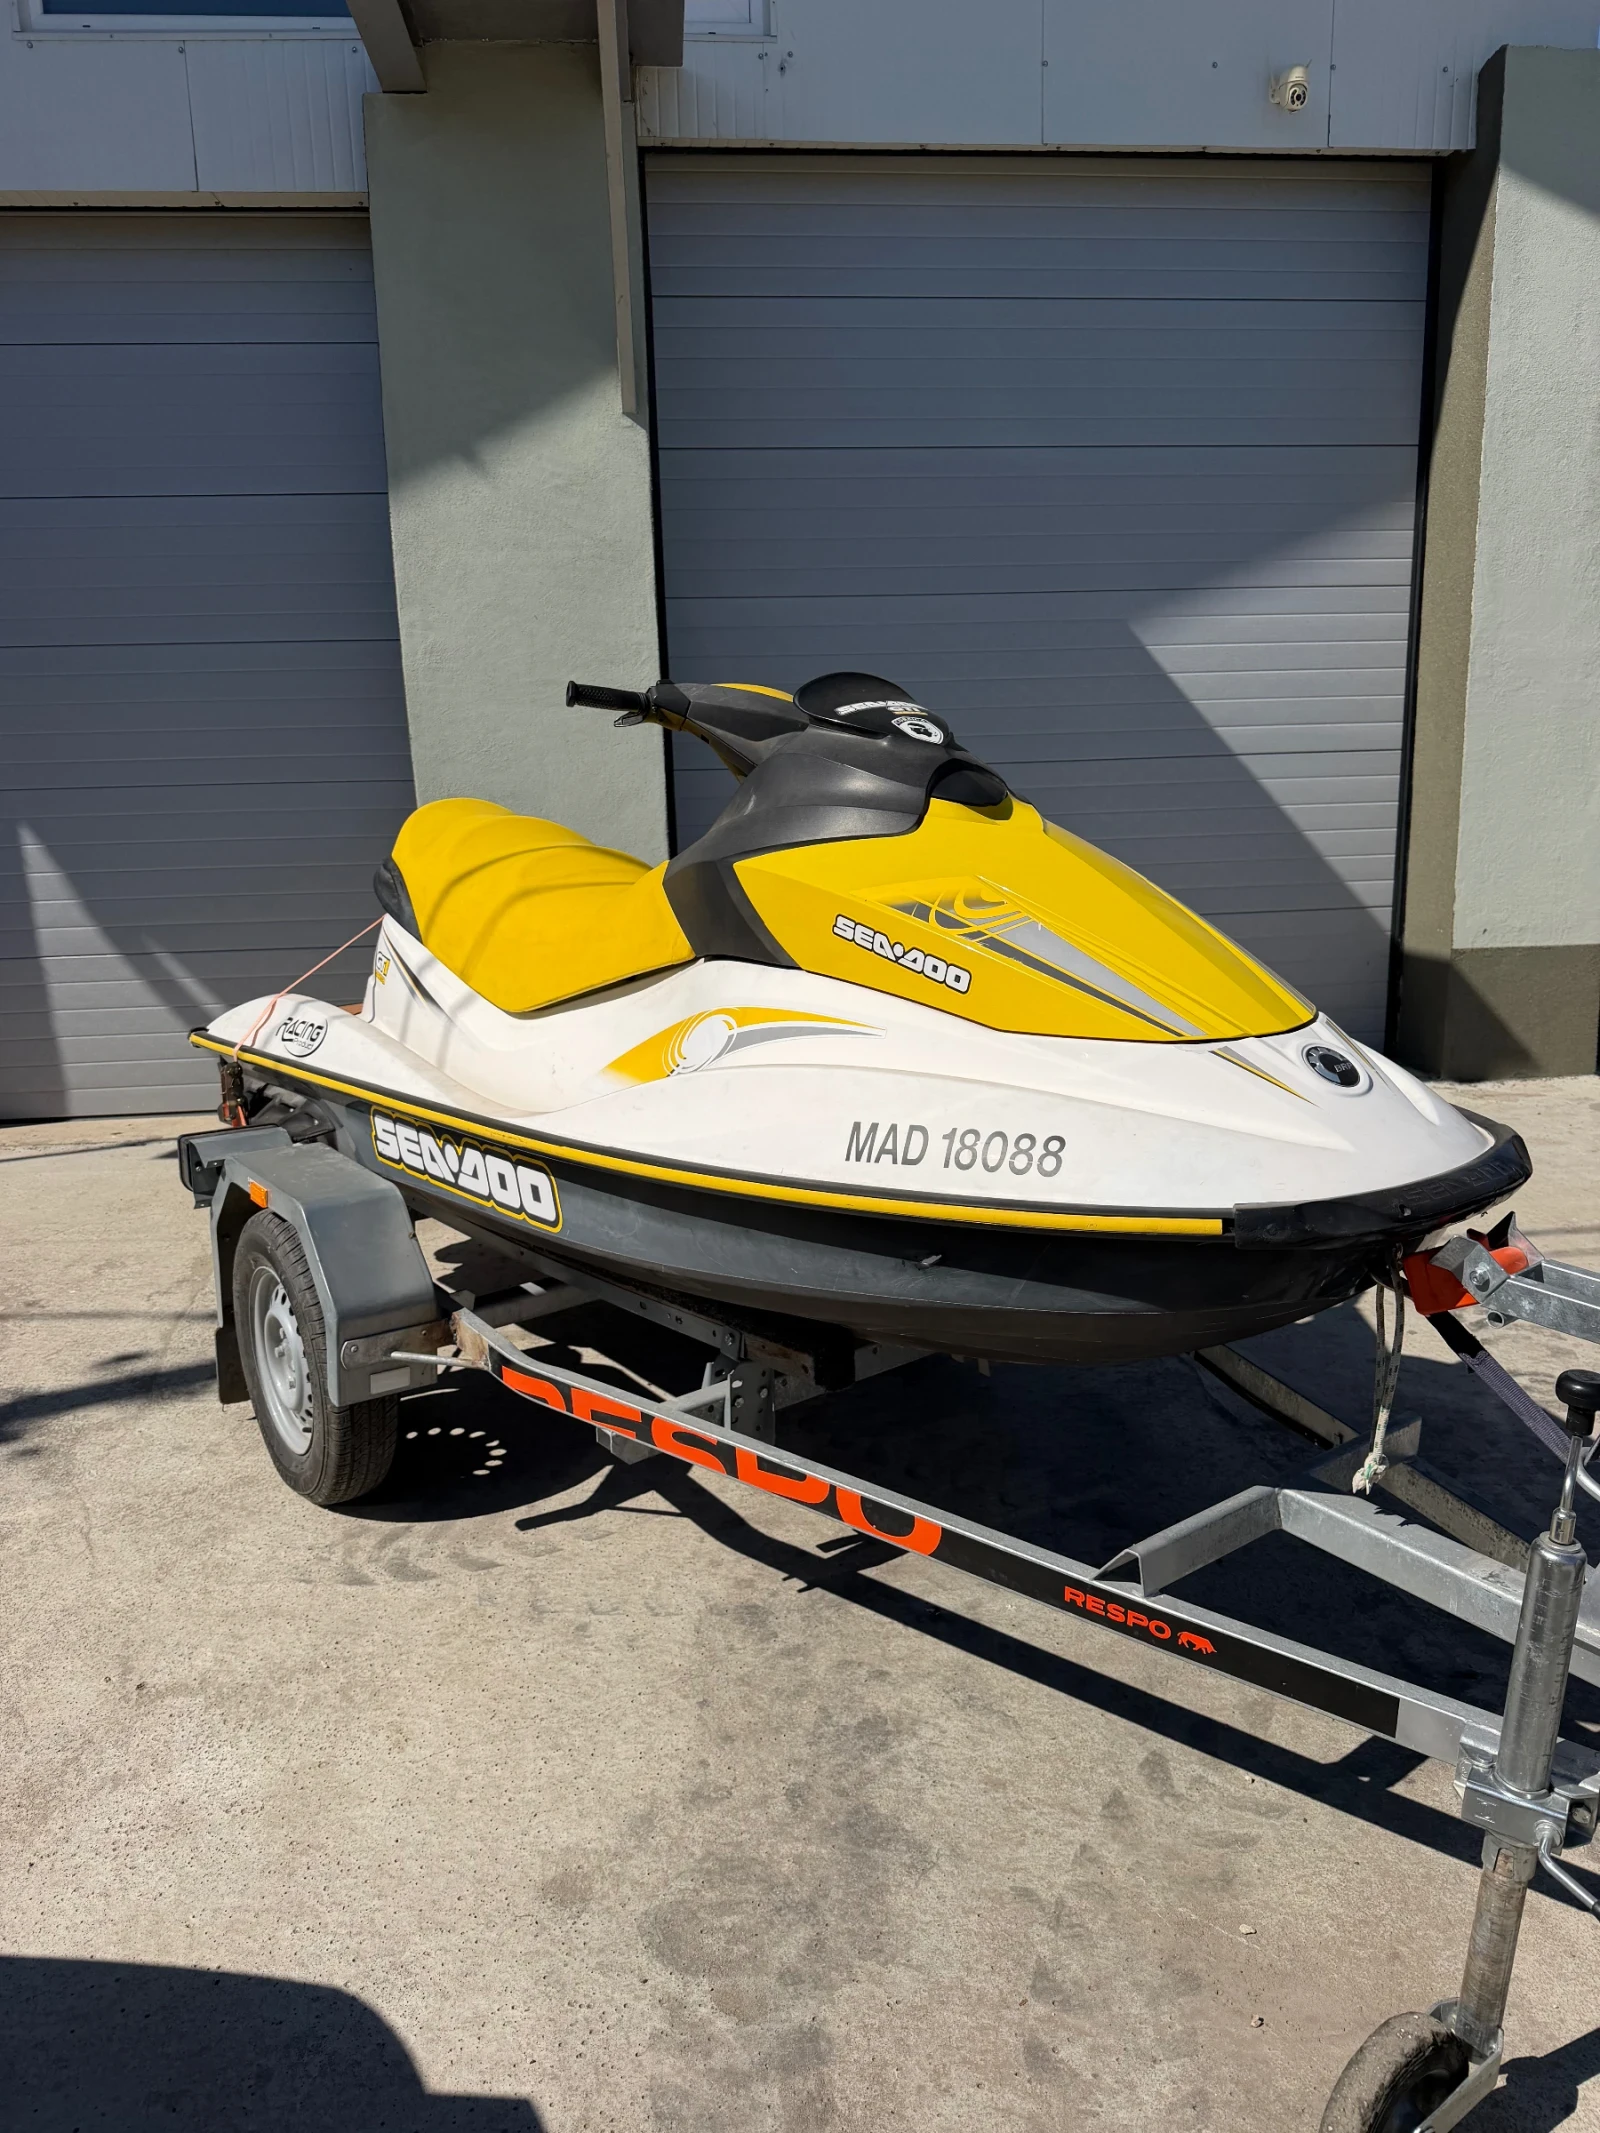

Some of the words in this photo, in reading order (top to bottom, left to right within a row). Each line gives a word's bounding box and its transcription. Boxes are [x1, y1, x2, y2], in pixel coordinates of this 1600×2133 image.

[1333, 1062, 1352, 1073] BRP
[845, 1121, 929, 1166] MAD
[941, 1127, 1066, 1178] 18088
[1064, 1585, 1172, 1639] RESPO
